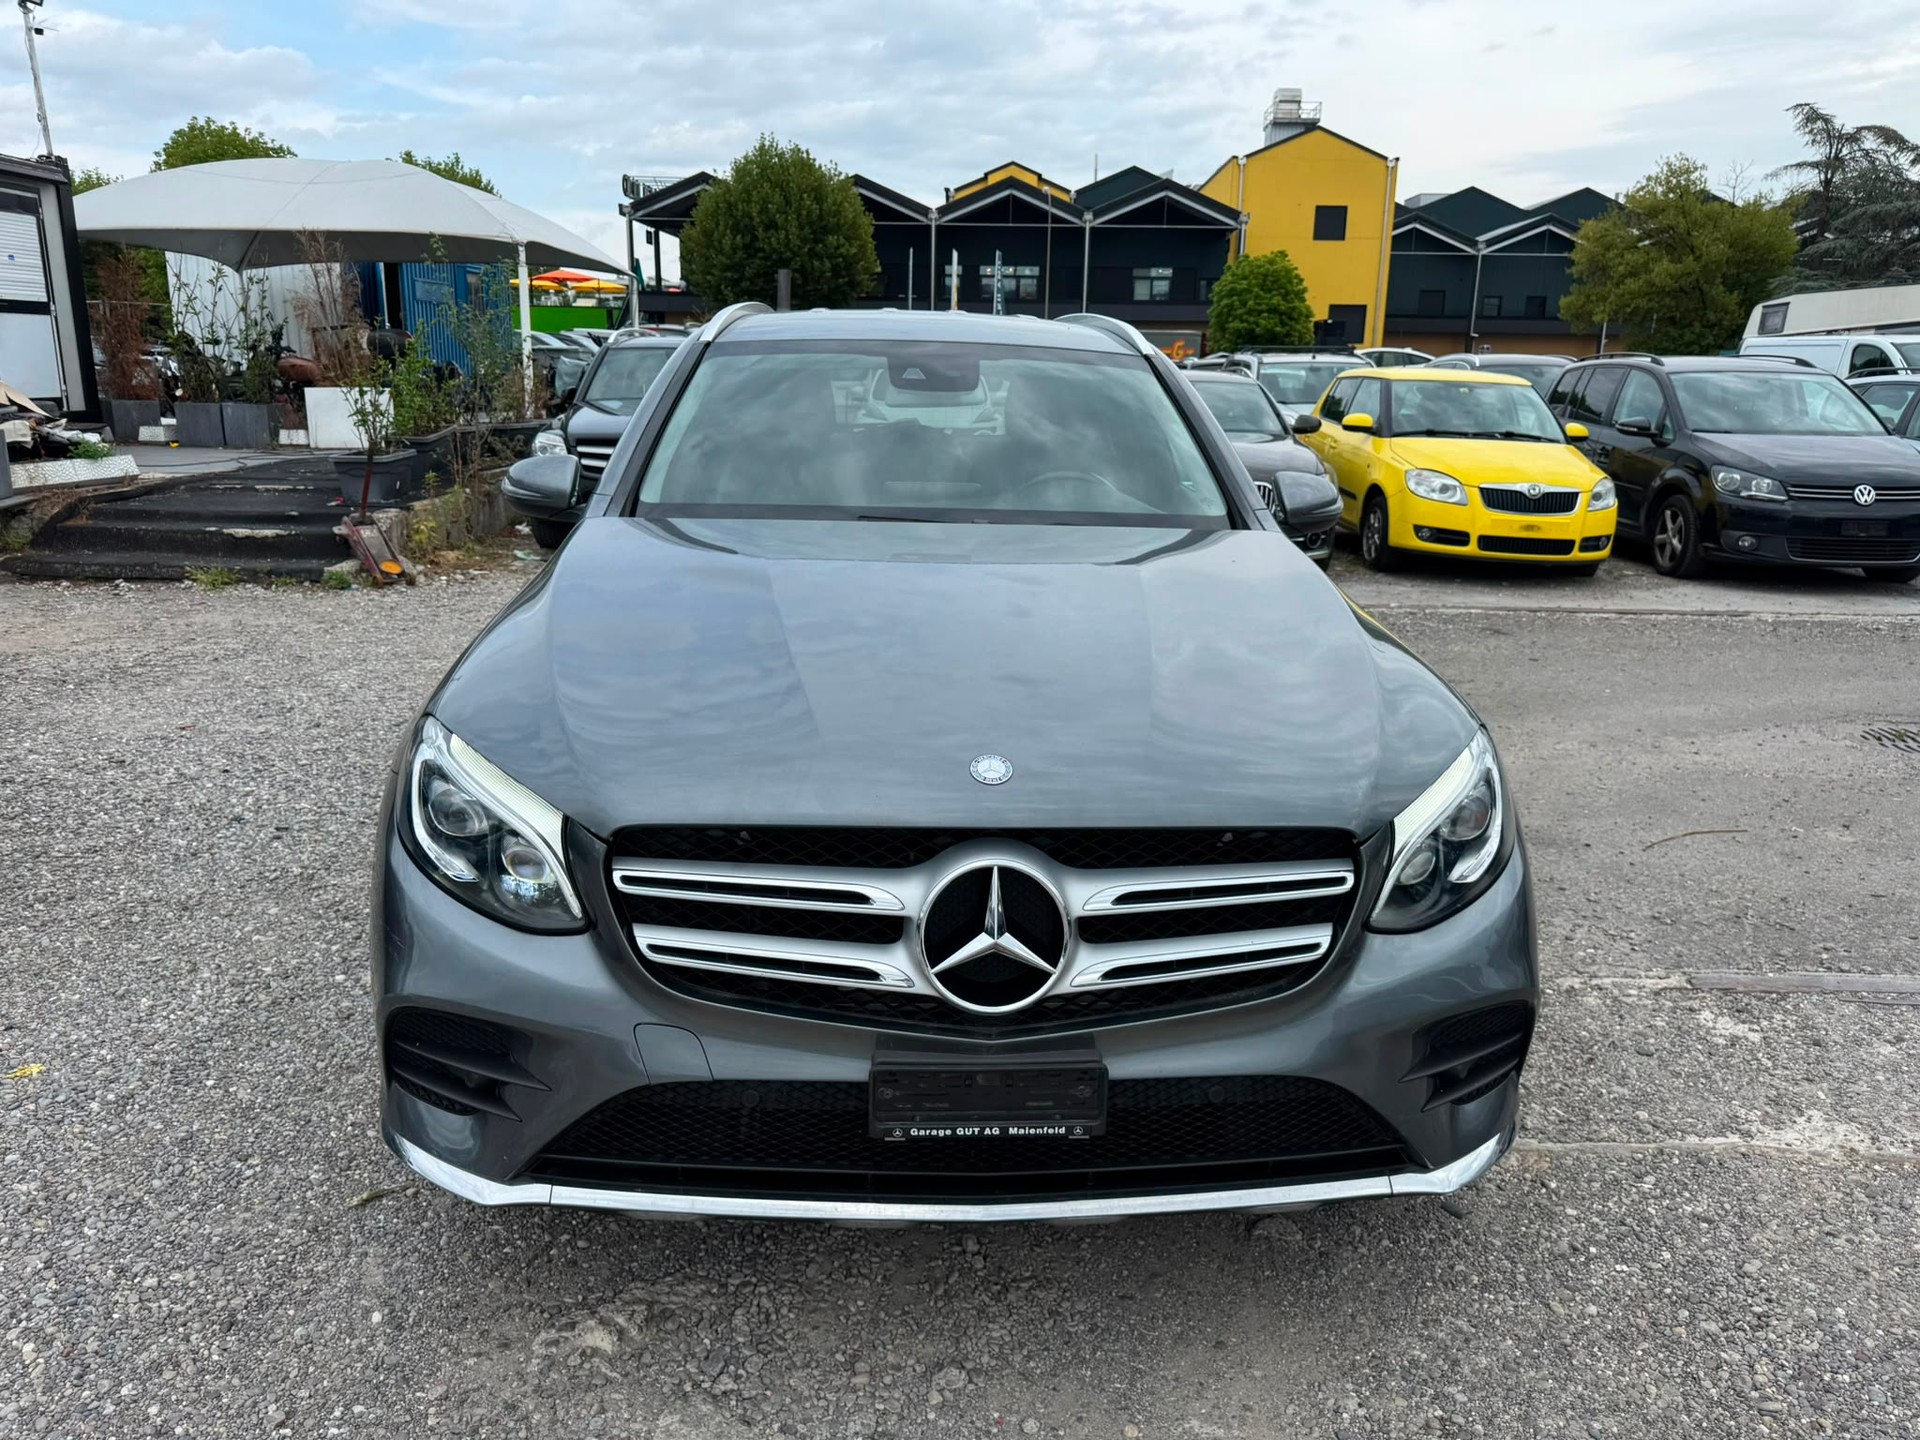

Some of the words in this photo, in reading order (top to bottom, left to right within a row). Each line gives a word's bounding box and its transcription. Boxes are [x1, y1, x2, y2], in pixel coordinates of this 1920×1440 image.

[910, 1127, 952, 1137] Garage
[956, 1127, 980, 1135] GUT
[984, 1127, 1000, 1135] AG
[1008, 1126, 1066, 1135] Maienfeld
